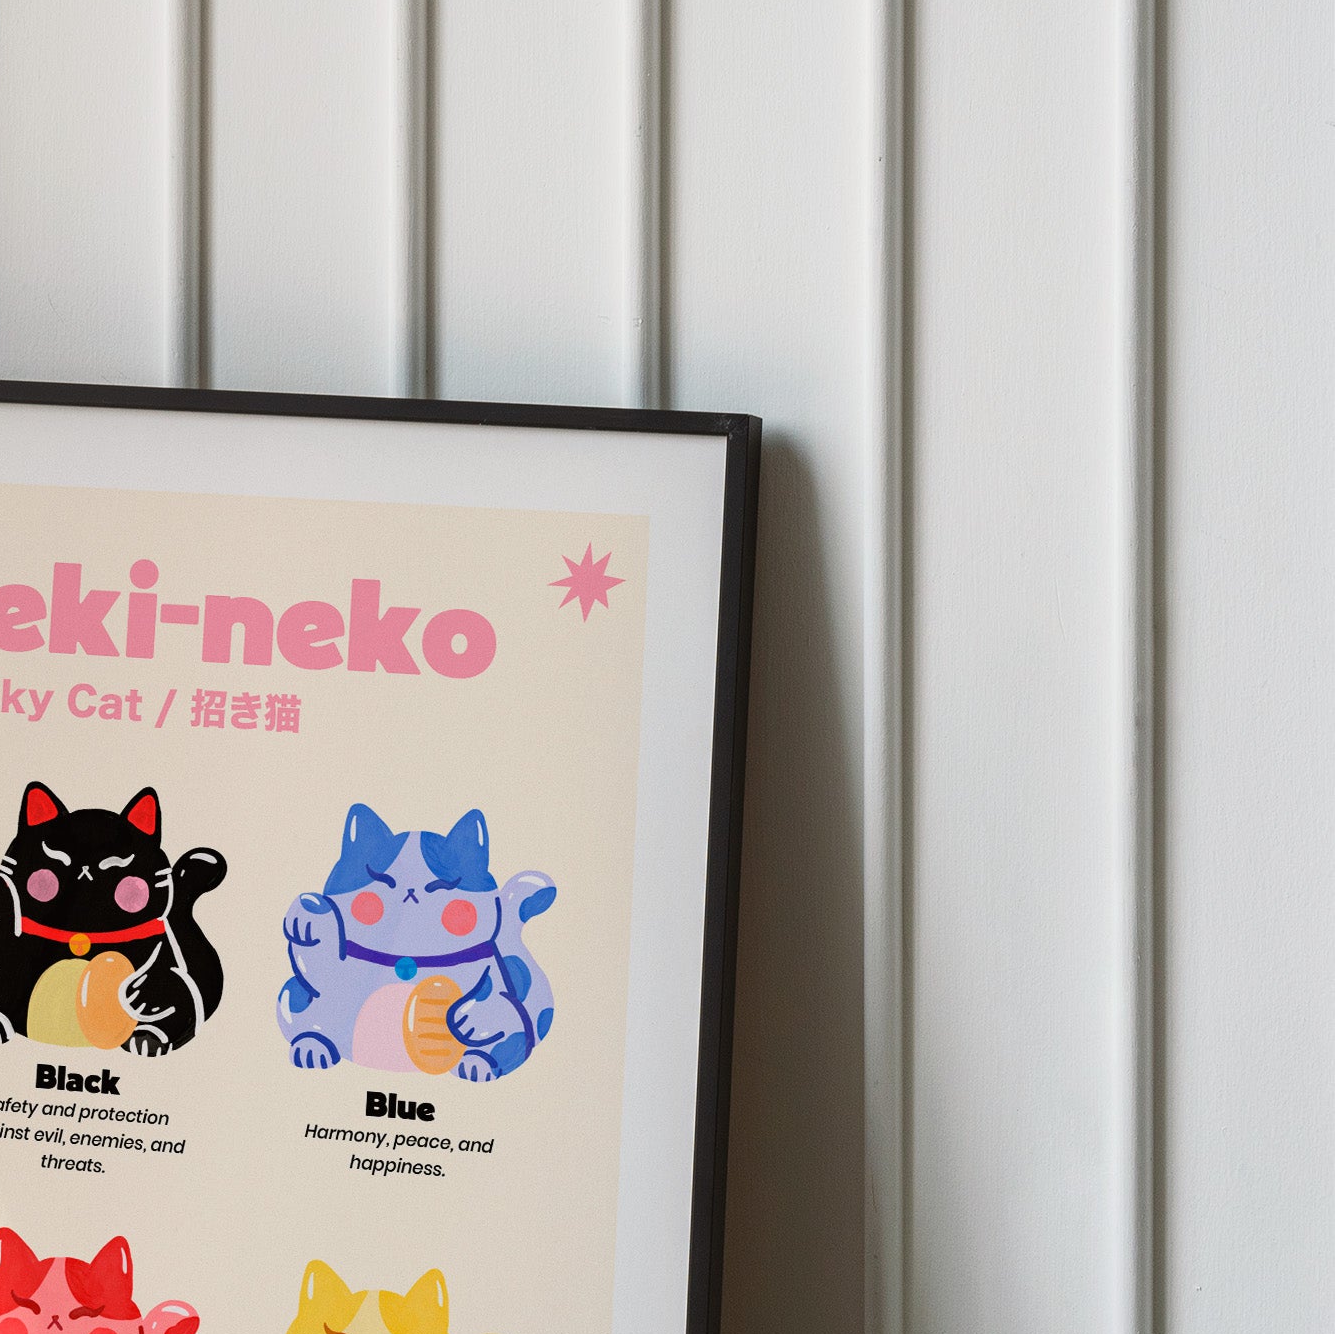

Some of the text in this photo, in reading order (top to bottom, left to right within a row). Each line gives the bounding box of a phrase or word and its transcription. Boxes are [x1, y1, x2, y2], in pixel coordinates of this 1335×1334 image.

[67, 682, 143, 723] Cat
[154, 688, 178, 729] /
[189, 687, 302, 734] 招き猫
[35, 1063, 121, 1096] Black
[41, 1103, 77, 1118] and
[77, 1107, 170, 1126] protection
[365, 1090, 436, 1122] Blue
[33, 1127, 66, 1146] evil,
[69, 1133, 147, 1153] enemies,
[150, 1139, 186, 1154] and
[304, 1123, 495, 1154] Harmony, peace, and
[41, 1154, 106, 1174] threats.
[349, 1154, 446, 1177] happiness.
